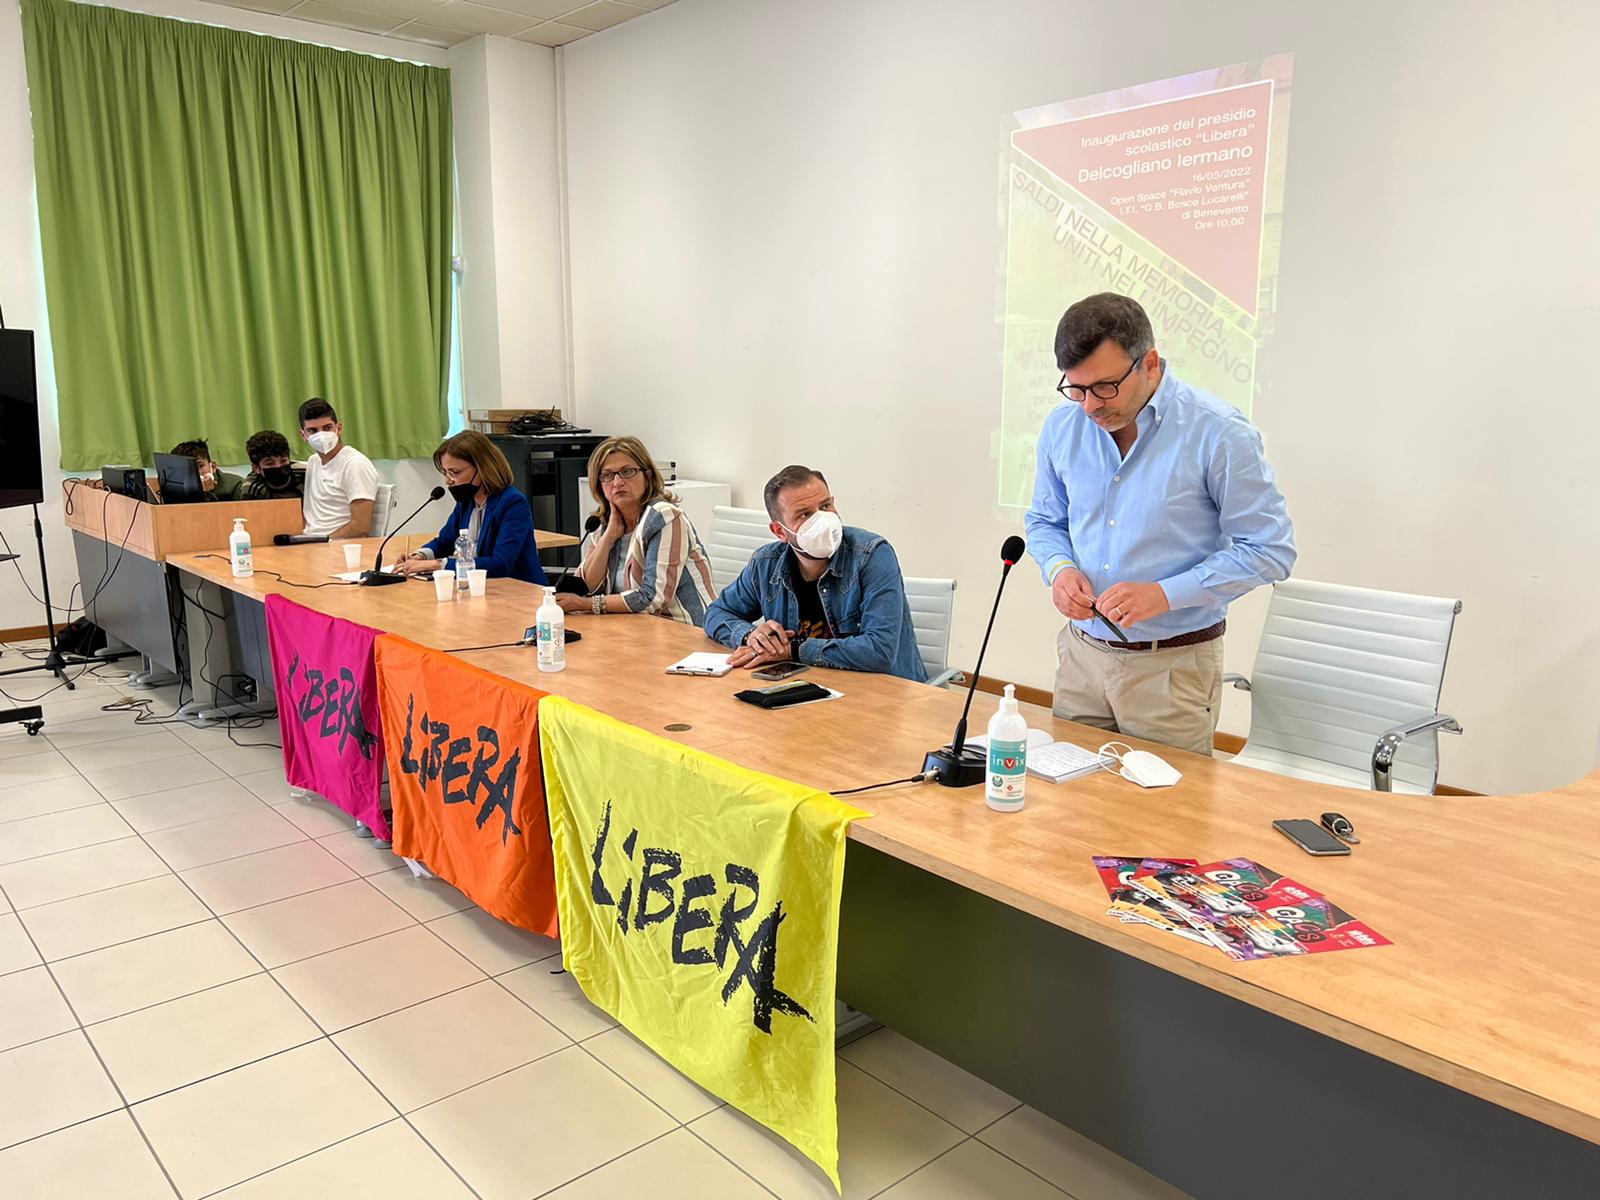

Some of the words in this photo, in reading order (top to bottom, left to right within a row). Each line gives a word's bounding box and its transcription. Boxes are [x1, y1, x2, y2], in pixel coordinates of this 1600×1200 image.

[1081, 124, 1169, 150] Inaugurazione
[1173, 117, 1194, 132] del
[1198, 107, 1256, 129] presidio
[1125, 136, 1192, 157] scolastico
[1078, 157, 1172, 183] Delcogliano
[1192, 166, 1252, 183] 16/05/2022
[1110, 194, 1135, 207] Open
[1137, 190, 1167, 204] Space
[1168, 197, 1199, 211] Bosco
[1181, 208, 1191, 220] di
[1193, 204, 1249, 219] Benevento
[1194, 219, 1214, 231] Ore
[1217, 217, 1245, 230] 10,00
[1052, 226, 1100, 271] UNITI
[1013, 171, 1065, 217] SALDI
[1065, 208, 1125, 264] NELLA
[1126, 254, 1228, 345] MEMORIA,
[992, 754, 1025, 768] invix
